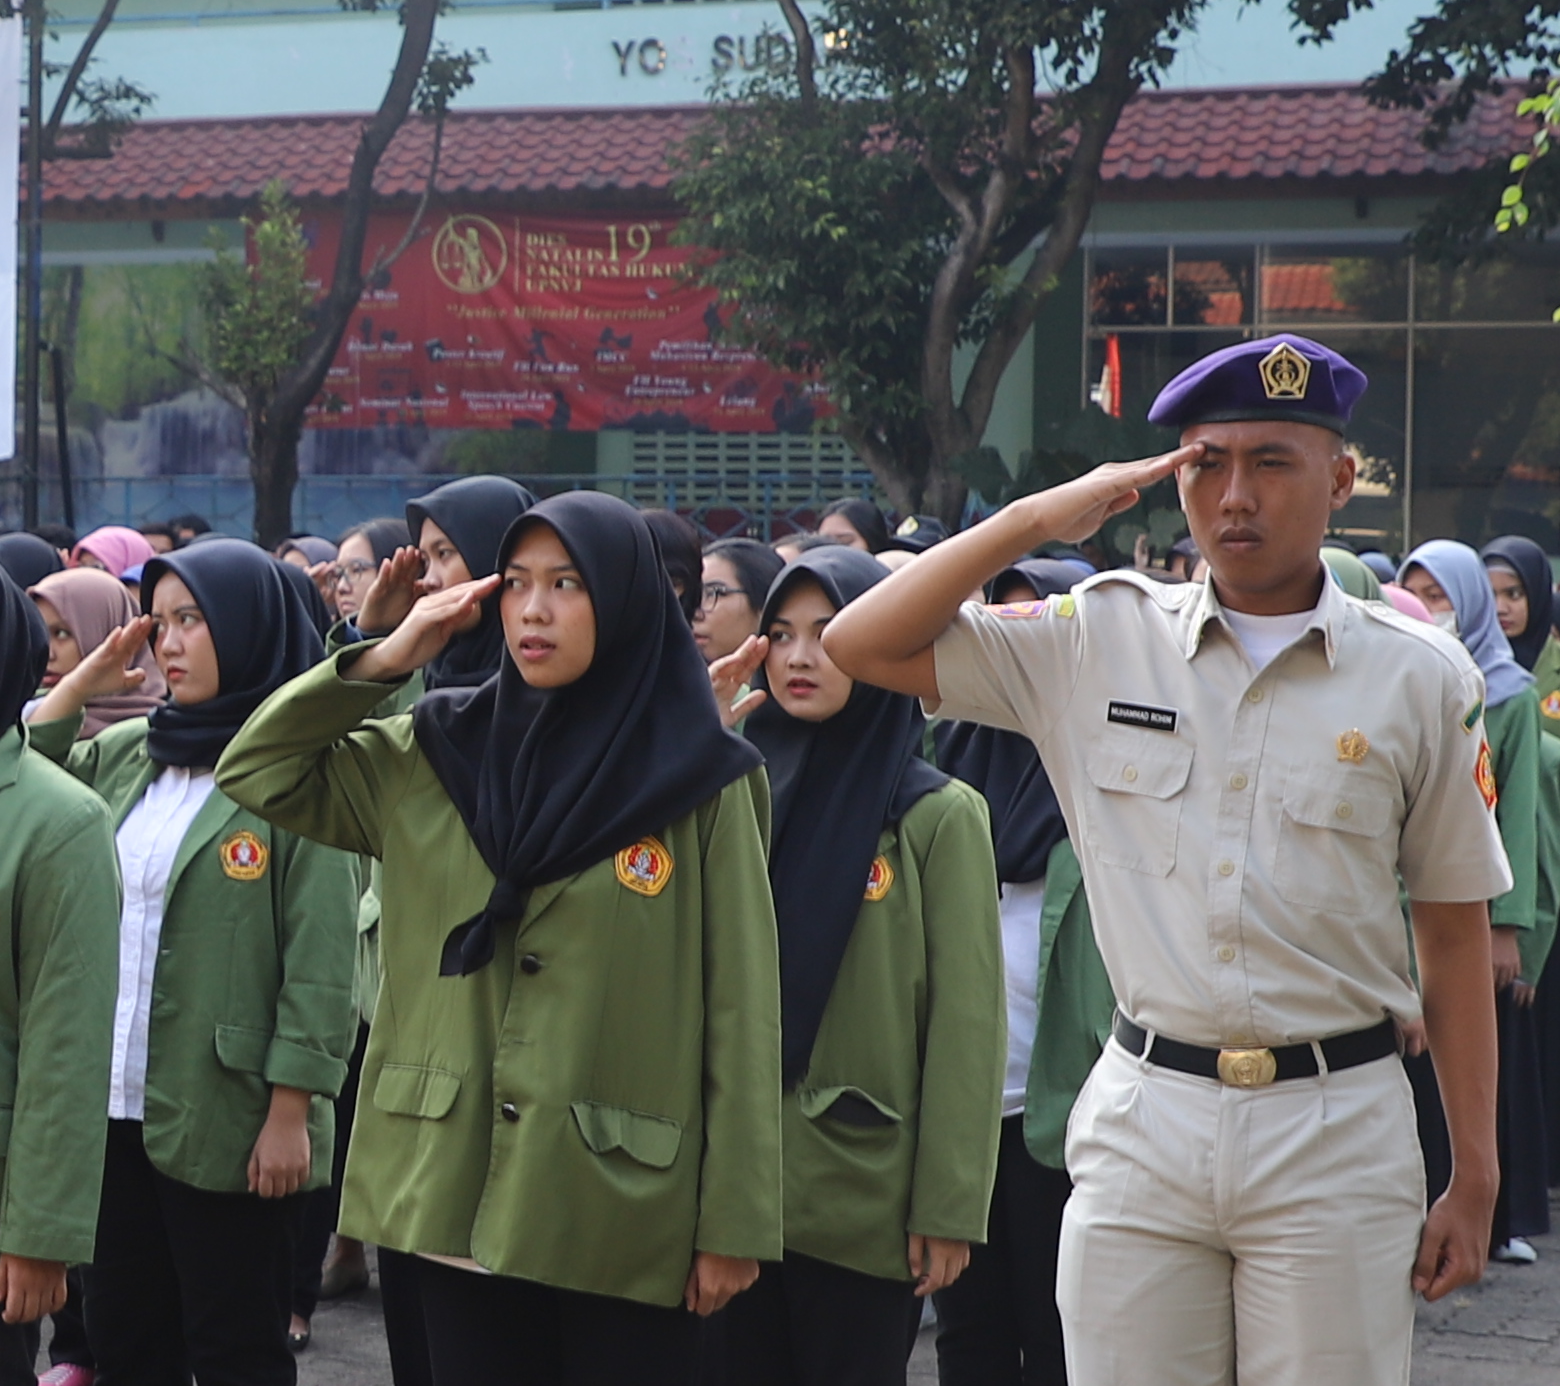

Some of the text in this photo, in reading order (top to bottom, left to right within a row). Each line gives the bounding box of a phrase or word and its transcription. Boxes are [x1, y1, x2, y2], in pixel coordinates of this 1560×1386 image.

[525, 233, 567, 247] DIES
[525, 248, 604, 263] NATALIS
[525, 263, 694, 278] FAKULTAS HUKUM
[525, 278, 582, 293] UPNVJ
